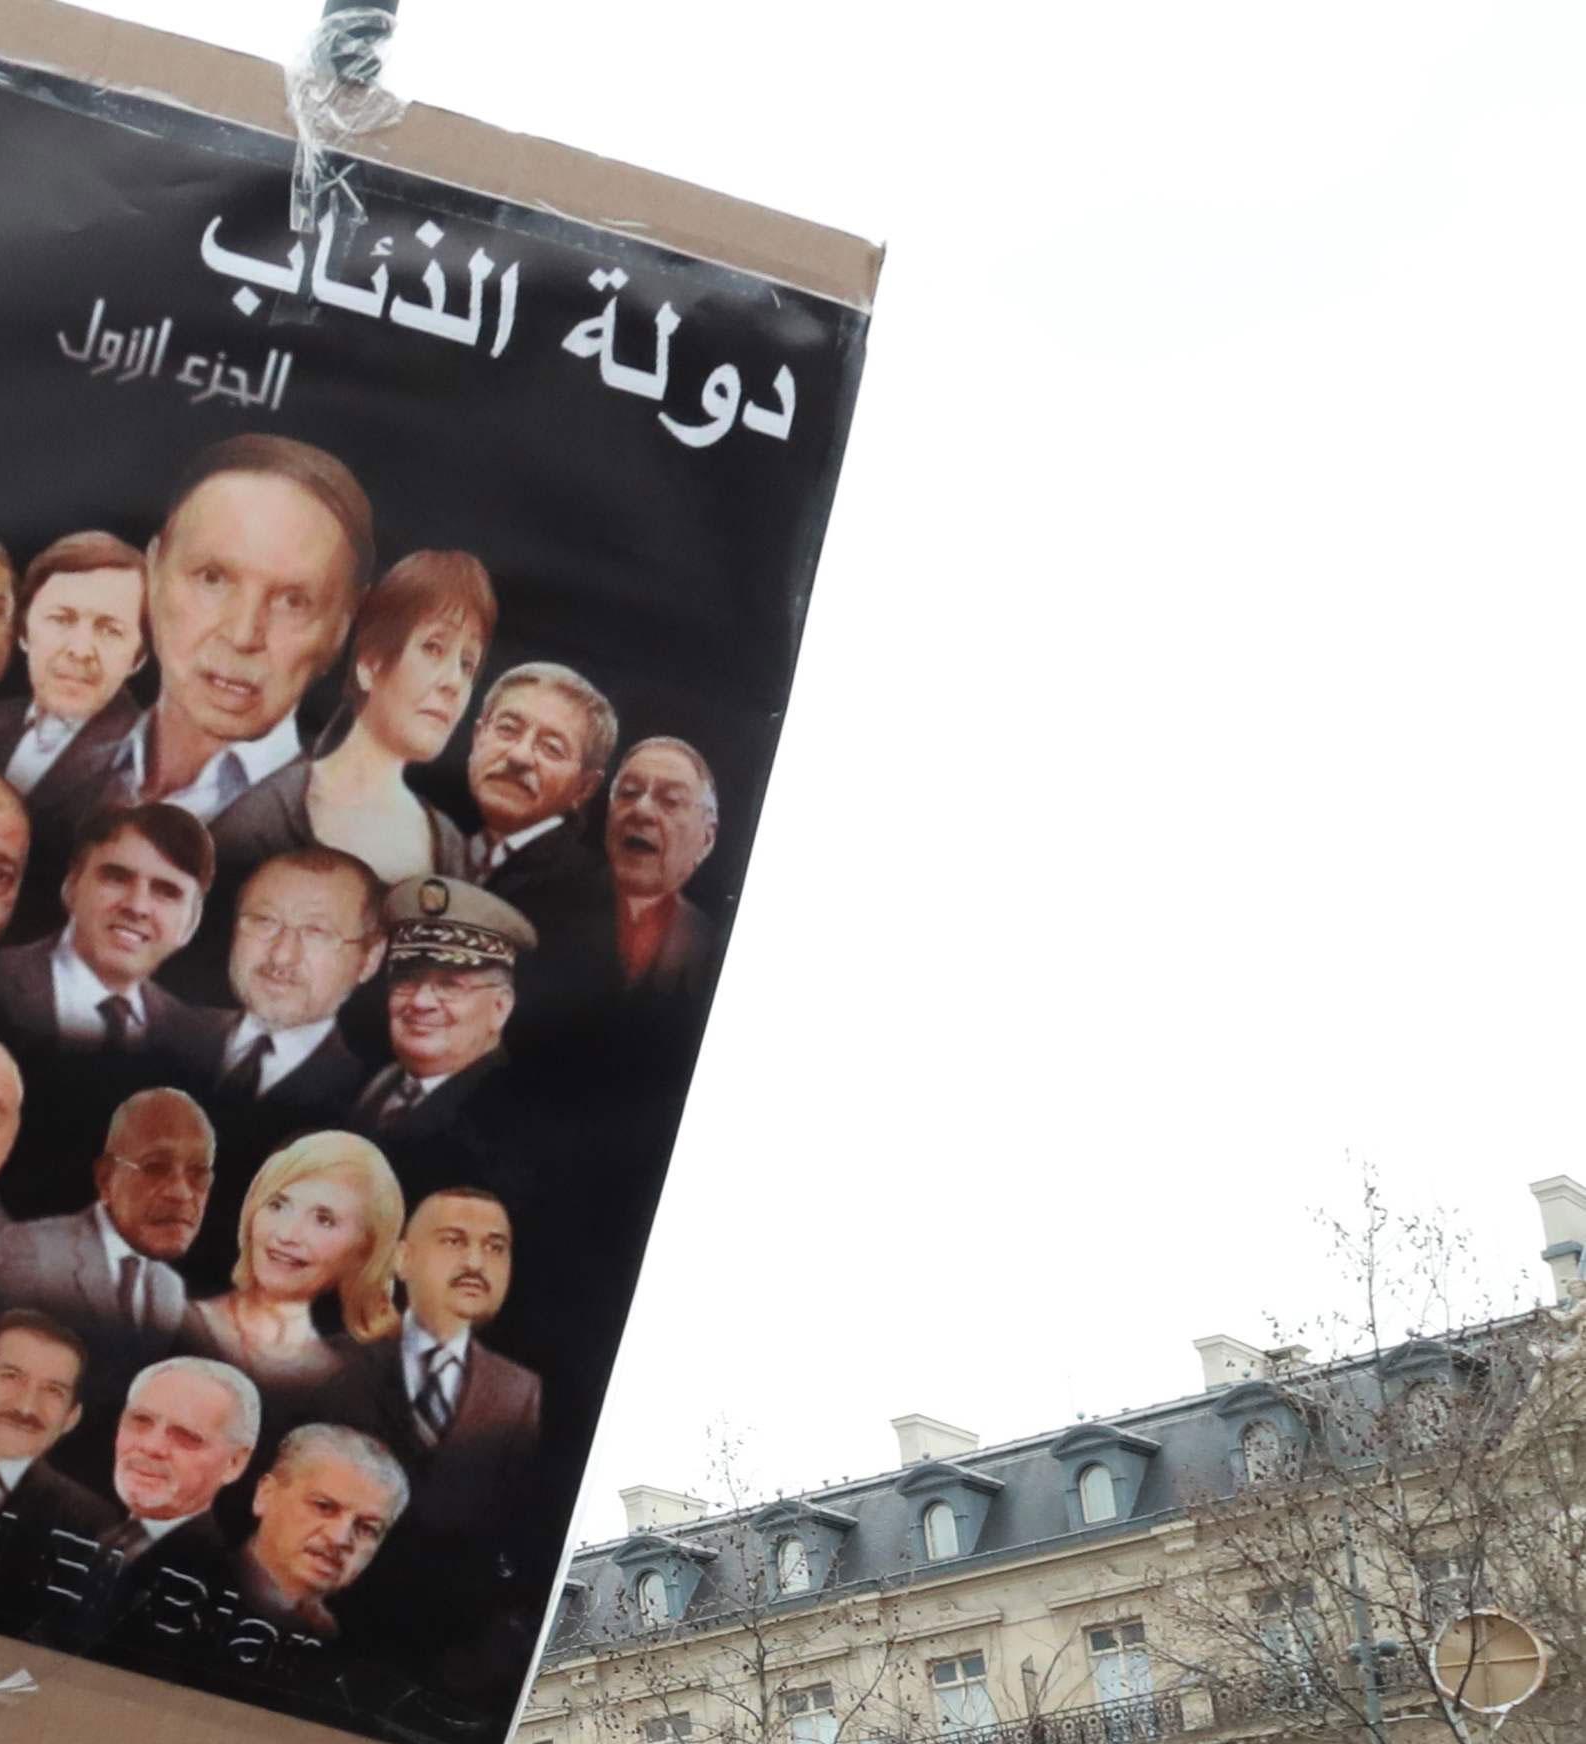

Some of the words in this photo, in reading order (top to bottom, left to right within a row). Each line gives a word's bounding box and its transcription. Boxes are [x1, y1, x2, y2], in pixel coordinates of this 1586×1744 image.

[198, 210, 521, 358] الذئاب
[561, 264, 797, 449] دولة
[175, 348, 293, 411] الجزء
